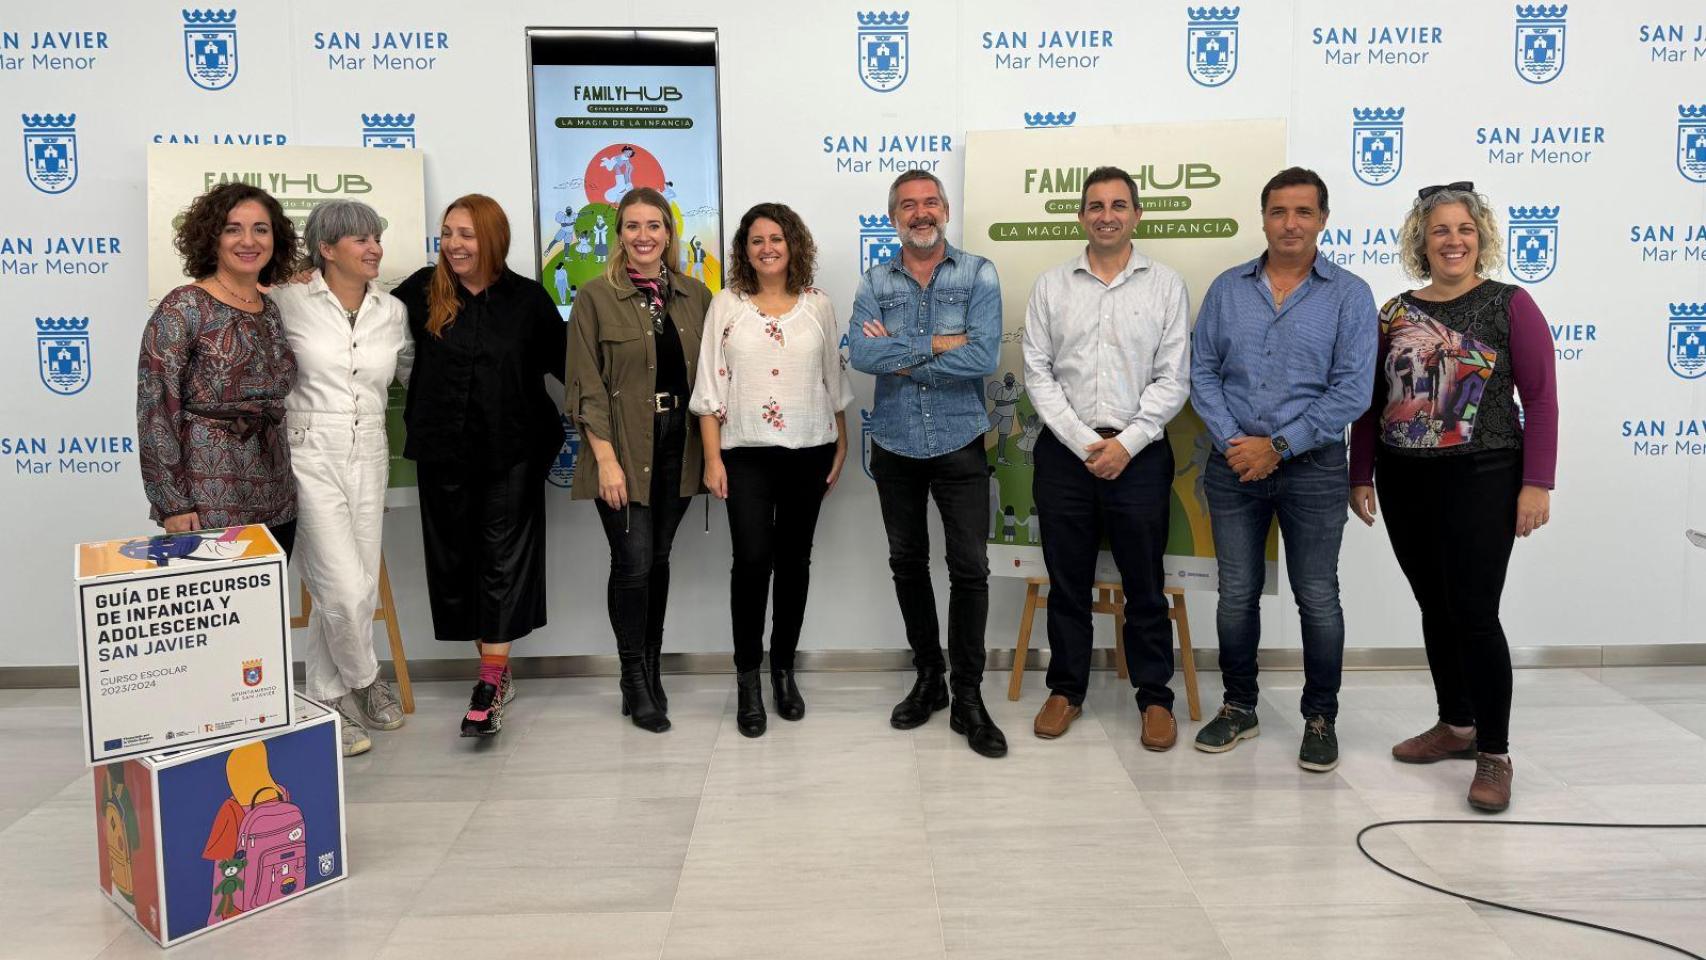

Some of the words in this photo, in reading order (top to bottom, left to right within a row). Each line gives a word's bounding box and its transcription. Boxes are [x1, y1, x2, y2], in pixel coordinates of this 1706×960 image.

[31, 31, 108, 49] JAVIER
[314, 32, 360, 49] SAN
[371, 31, 449, 49] JAVIER
[982, 31, 1027, 49] SAN
[1038, 30, 1113, 48] JAVIER
[1312, 27, 1357, 44] SAN
[1368, 26, 1443, 44] JAVIER
[1639, 25, 1684, 42] SAN
[0, 54, 25, 70] ar
[32, 53, 96, 70] Menor
[328, 53, 366, 70] Mar
[373, 53, 436, 70] Menor
[995, 53, 1031, 69] Mar
[1038, 52, 1100, 68] Menor
[1325, 48, 1361, 64] Mar
[1368, 48, 1429, 64] Menor
[1651, 46, 1687, 62] Mar
[577, 119, 608, 127] MAGIA
[612, 119, 625, 127] DE
[629, 119, 641, 127] LA
[644, 119, 691, 127] INFANCIA
[823, 135, 868, 153] SAN
[877, 135, 953, 152] JAVIER
[1476, 127, 1520, 145] SAN
[1531, 126, 1605, 143] JAVIER
[1488, 148, 1524, 164] Mar
[1531, 147, 1592, 163] Menor
[836, 157, 872, 173] Mar
[879, 156, 939, 172] Menor
[1138, 199, 1188, 209] amilias
[1000, 226, 1018, 237] LA
[1028, 225, 1079, 236] MAGIA
[1146, 222, 1233, 233] INFANCIA
[1320, 229, 1352, 245] AN
[1630, 225, 1674, 242] SAN
[0, 238, 33, 255] AN
[45, 237, 122, 254] JAVIER
[1642, 246, 1678, 261] Mar
[2, 259, 39, 275] Mar
[46, 259, 109, 274] Menor
[1550, 325, 1597, 341] VIER
[1554, 348, 1583, 360] nor
[1621, 420, 1665, 437] SAN
[1, 438, 46, 455] SAN
[57, 437, 134, 454] JAVIER
[1633, 440, 1669, 456] Mar
[16, 458, 52, 474] Mar
[59, 458, 121, 473] Menor
[95, 588, 142, 609] GUÍA
[147, 586, 171, 602] DE
[176, 573, 271, 598] RECURSOS
[97, 610, 121, 627] DE
[127, 598, 215, 623] INFANCIA
[219, 595, 231, 609] Y
[97, 611, 241, 645] ADOLESCENCIA
[99, 643, 139, 662] SAN
[143, 633, 208, 656] JAVIER
[100, 673, 138, 686] CURSO
[140, 665, 188, 679] ESCOLAR
[101, 679, 157, 696] 2023/2024
